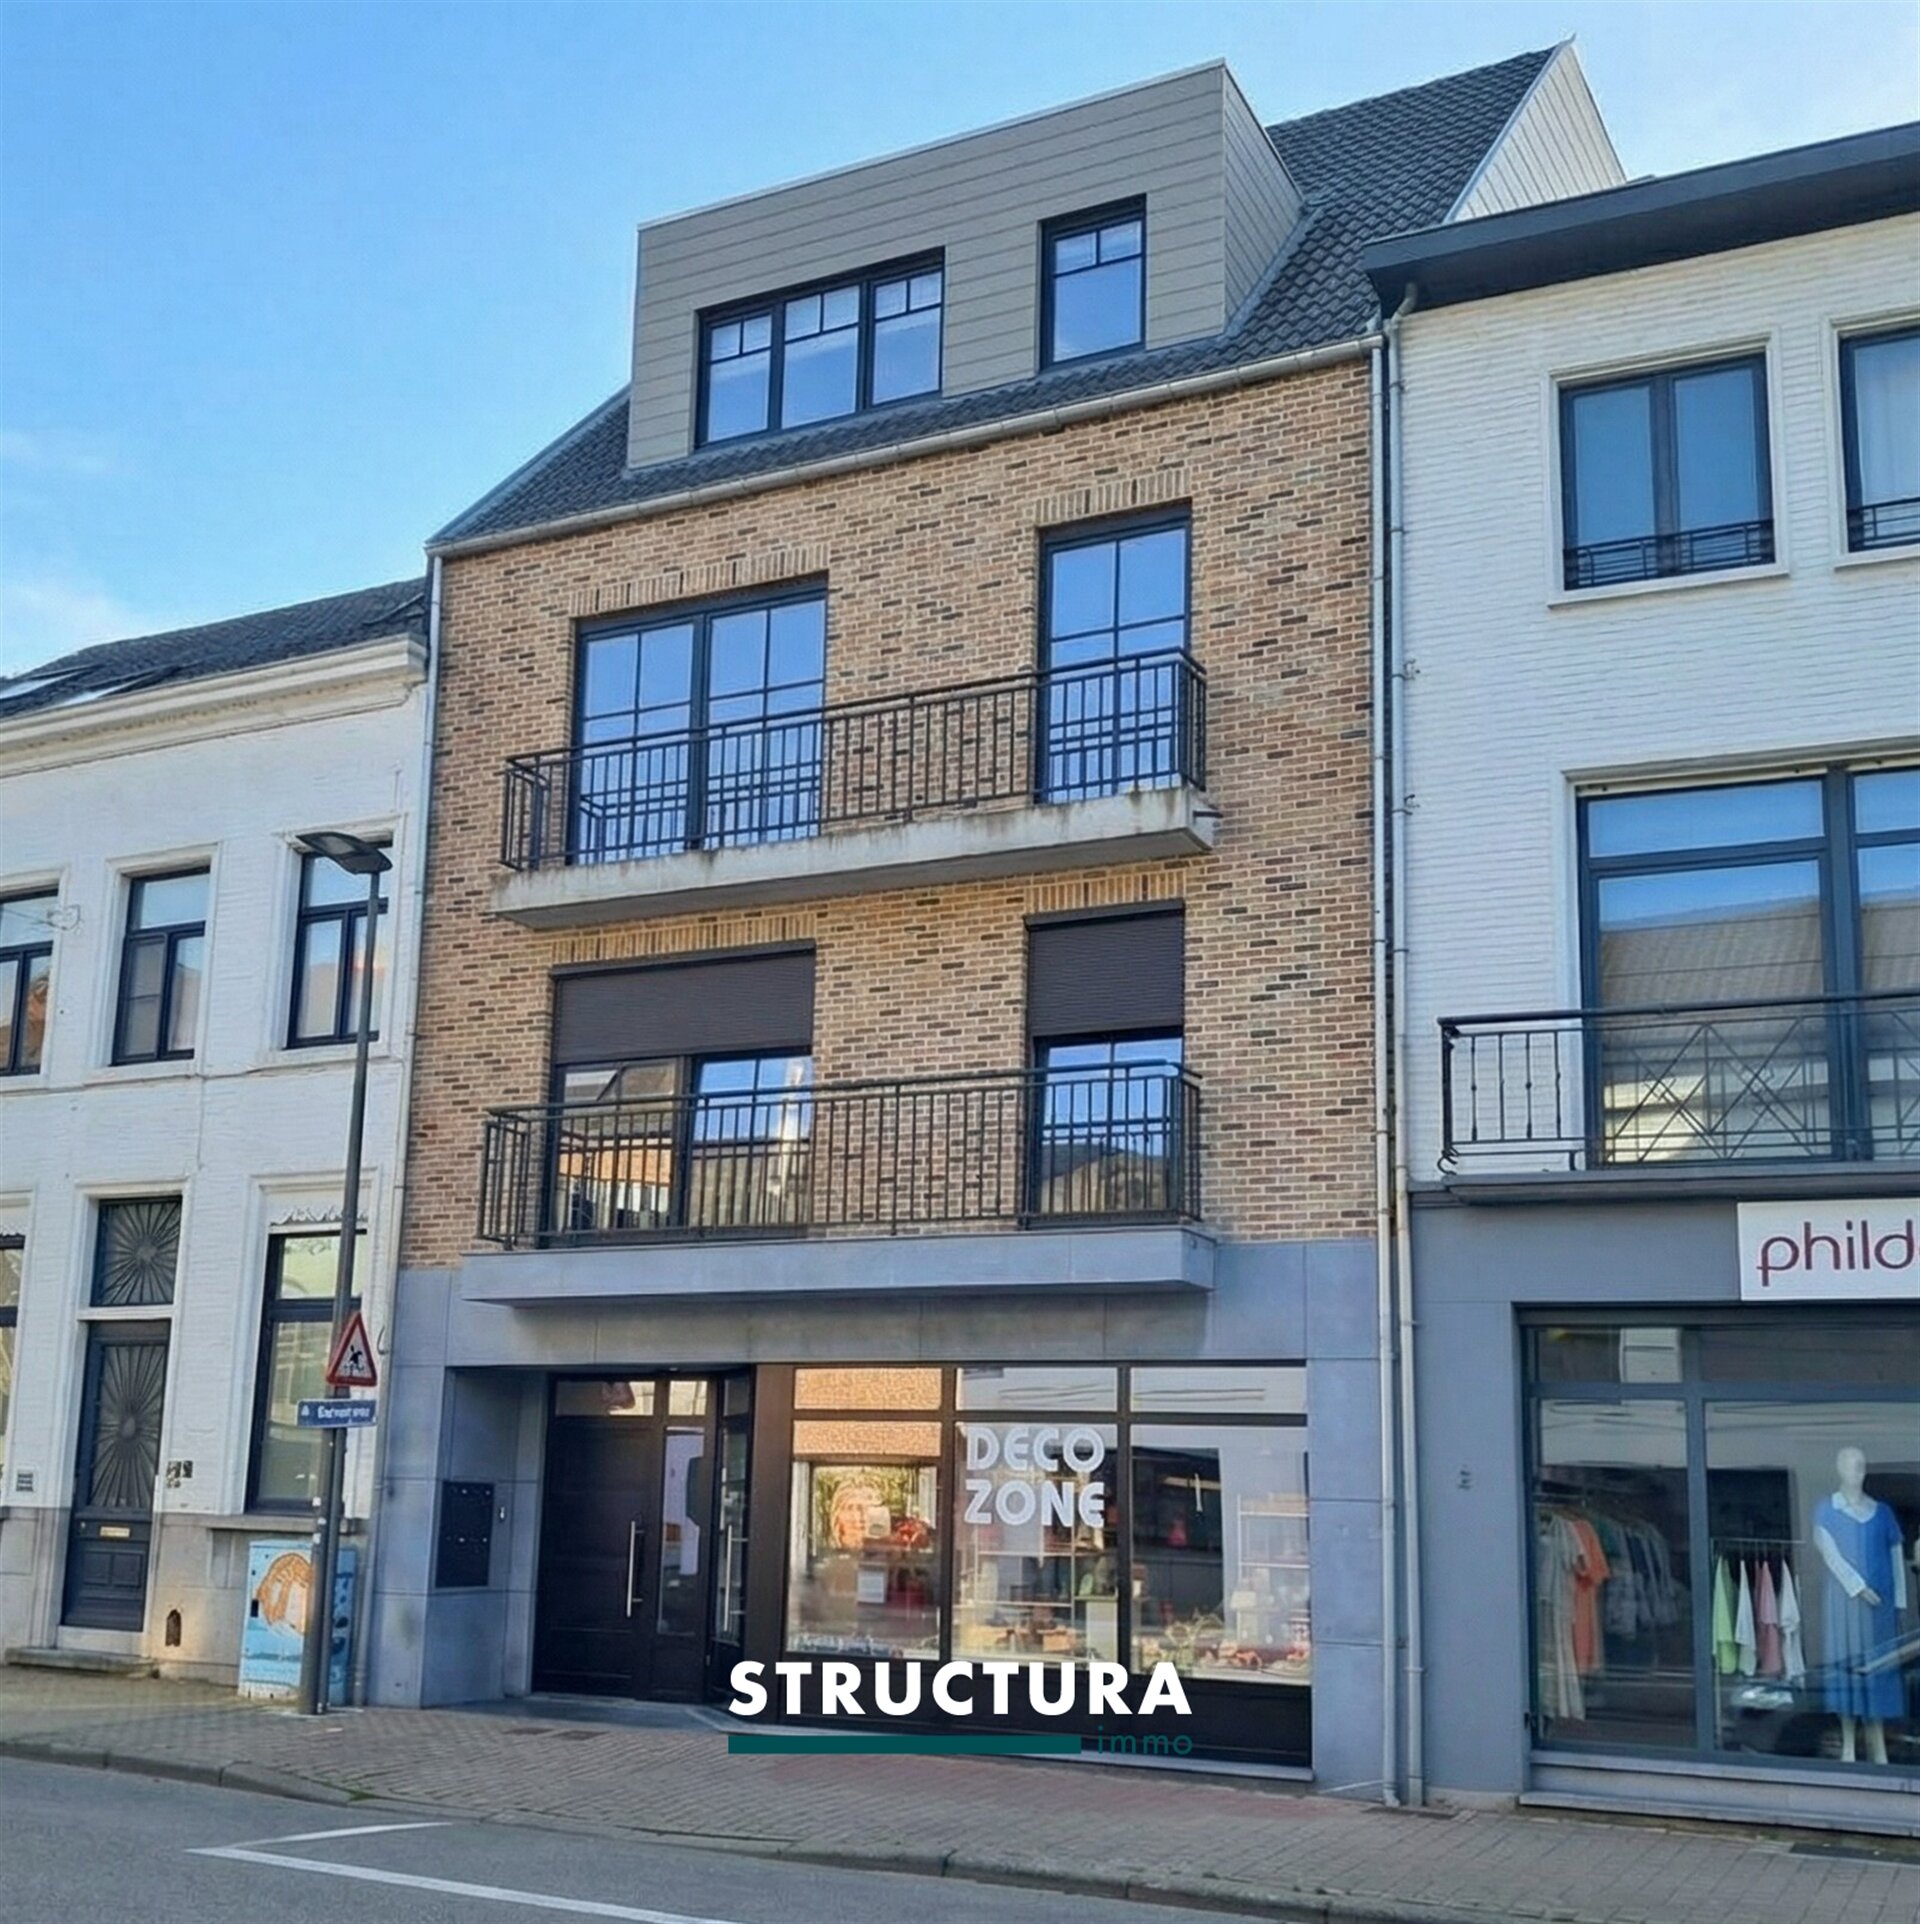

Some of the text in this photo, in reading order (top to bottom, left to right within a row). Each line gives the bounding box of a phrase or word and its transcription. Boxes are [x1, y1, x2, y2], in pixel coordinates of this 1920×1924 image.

[1756, 1219, 1920, 1287] phild
[966, 1426, 1105, 1473] DECO
[964, 1478, 1105, 1528] ZONE
